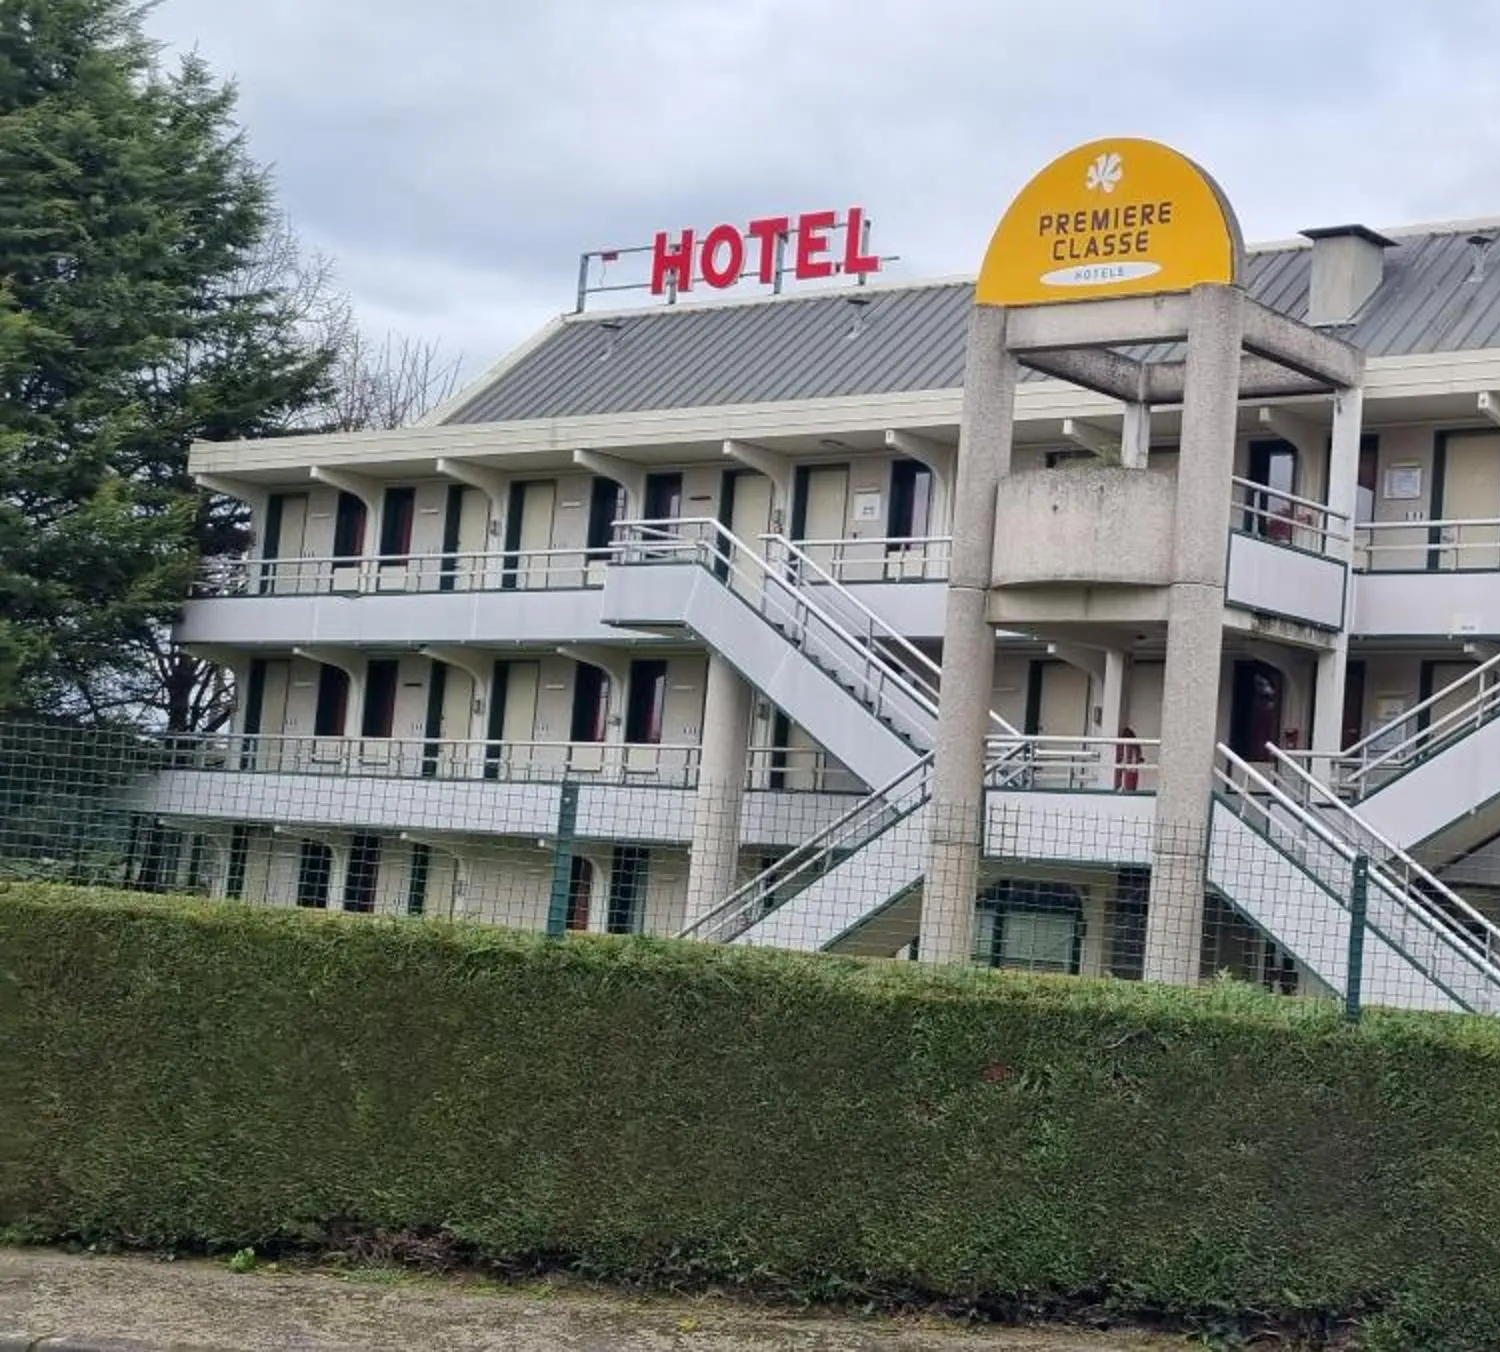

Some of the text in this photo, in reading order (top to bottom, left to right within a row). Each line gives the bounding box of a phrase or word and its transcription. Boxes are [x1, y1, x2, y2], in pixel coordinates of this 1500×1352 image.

[1039, 201, 1173, 236] PREMIERE
[651, 206, 881, 295] HOTEL
[1052, 230, 1149, 261] CLASSE
[1074, 266, 1125, 281] HOTELS
